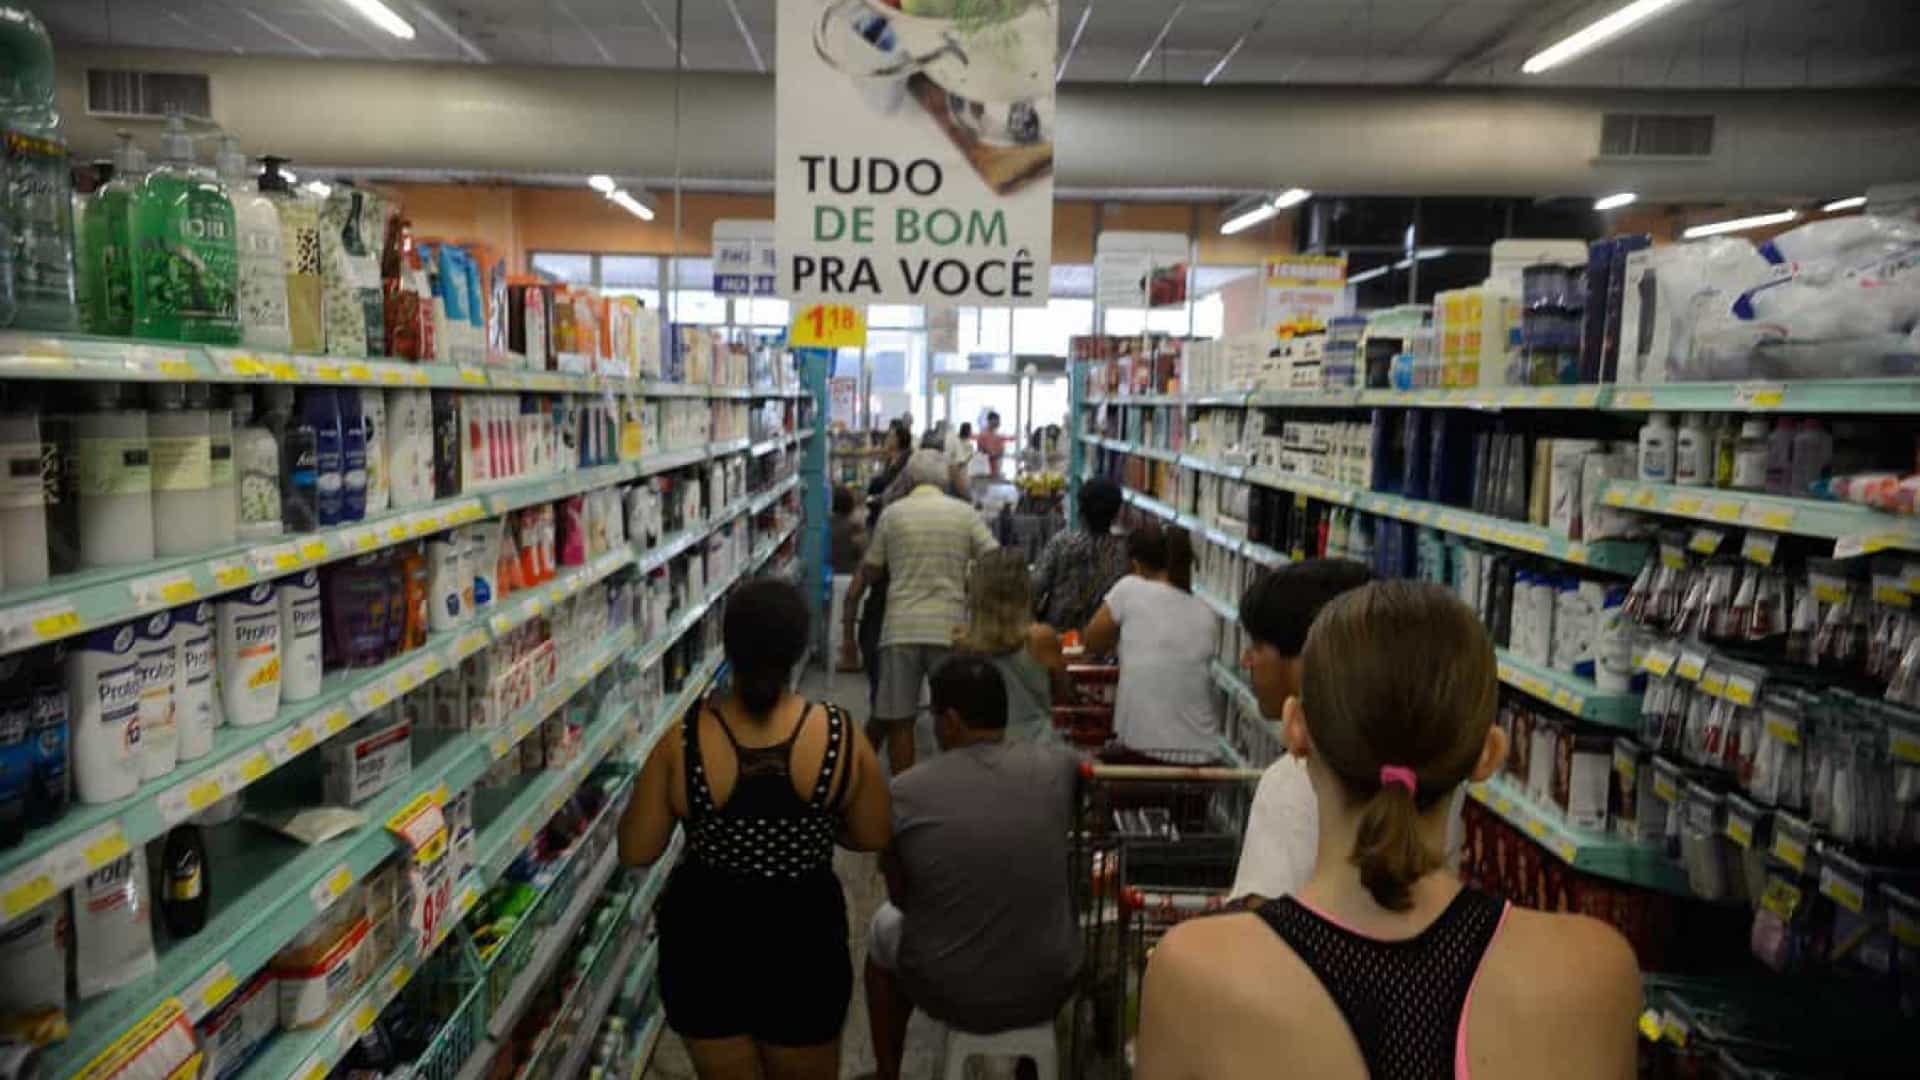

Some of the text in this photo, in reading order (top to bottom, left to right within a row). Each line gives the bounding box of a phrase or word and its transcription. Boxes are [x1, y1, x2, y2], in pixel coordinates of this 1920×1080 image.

[799, 155, 943, 196] TUDO
[813, 205, 1008, 246] DE BOM
[792, 255, 882, 293] PRA
[898, 249, 1035, 297] VOCÊ
